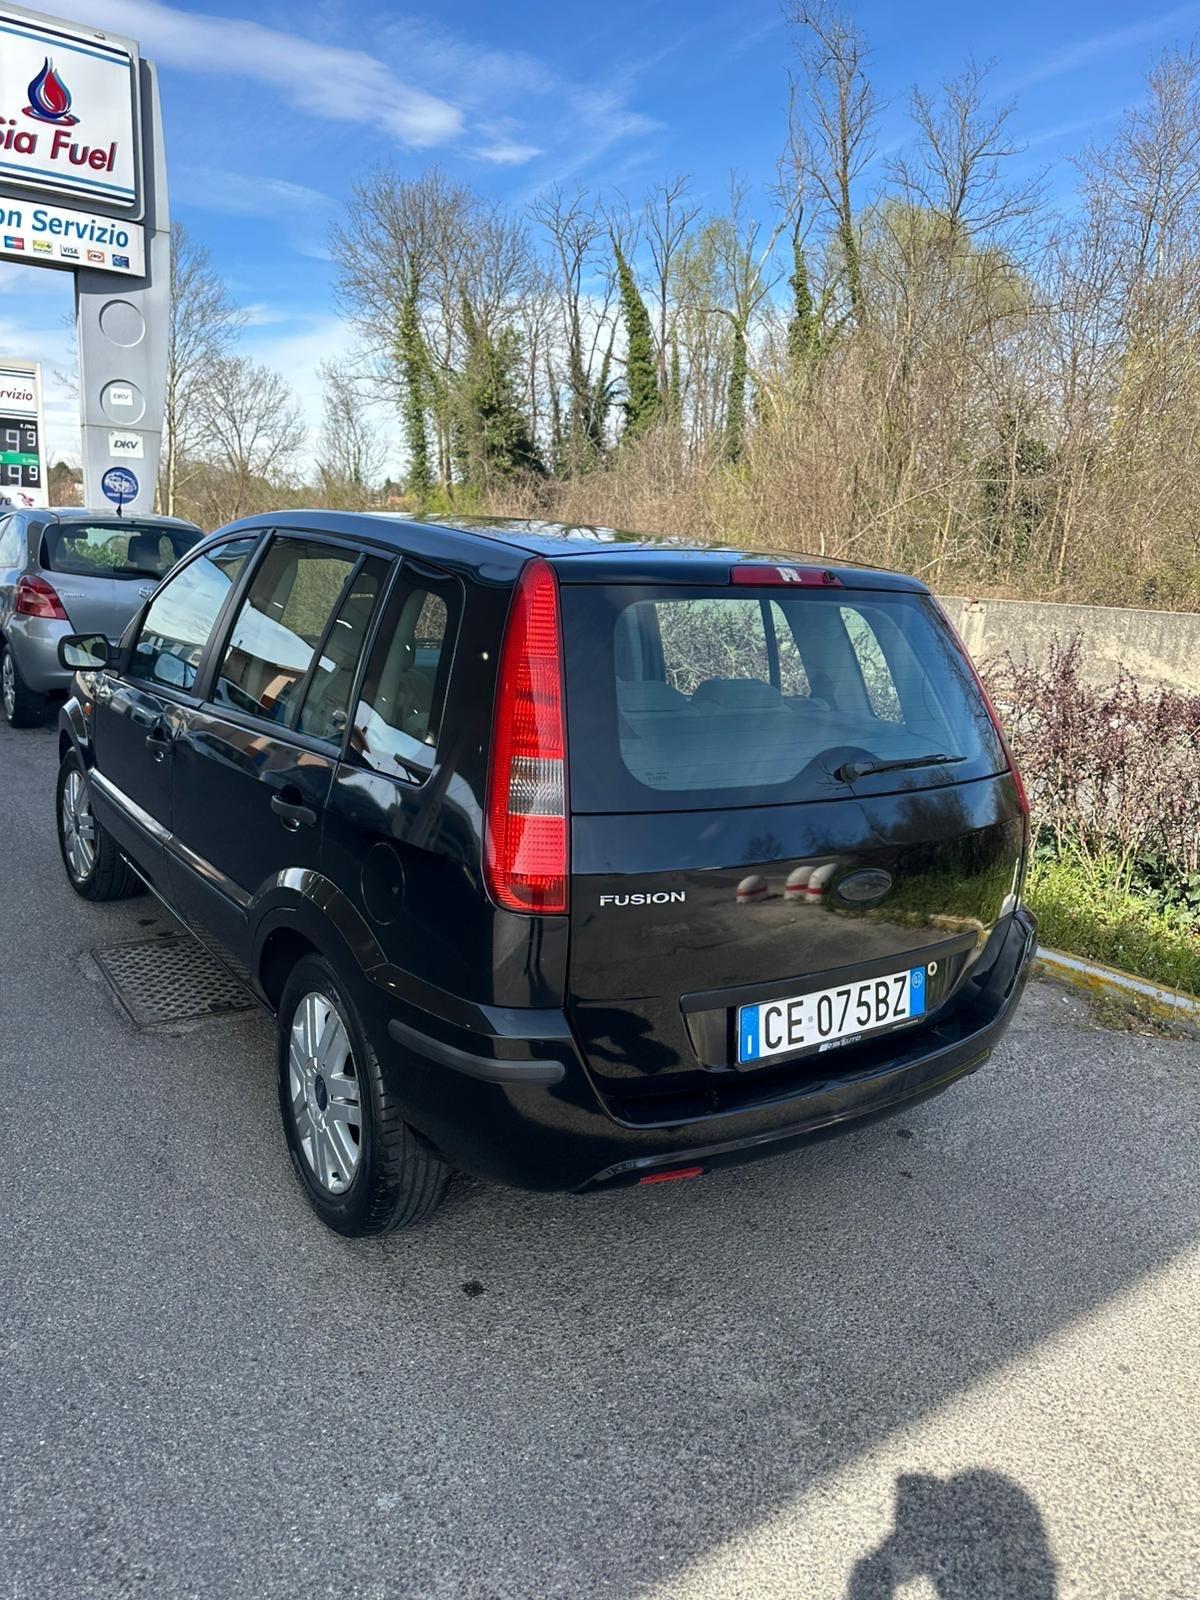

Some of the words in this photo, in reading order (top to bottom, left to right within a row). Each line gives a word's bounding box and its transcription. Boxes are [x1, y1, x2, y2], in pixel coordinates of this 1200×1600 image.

[50, 130, 118, 172] Fuel
[31, 209, 129, 248] Servizio
[63, 246, 79, 255] VISA
[114, 440, 138, 449] DKV
[599, 891, 686, 907] FUSION
[747, 1034, 753, 1055] I
